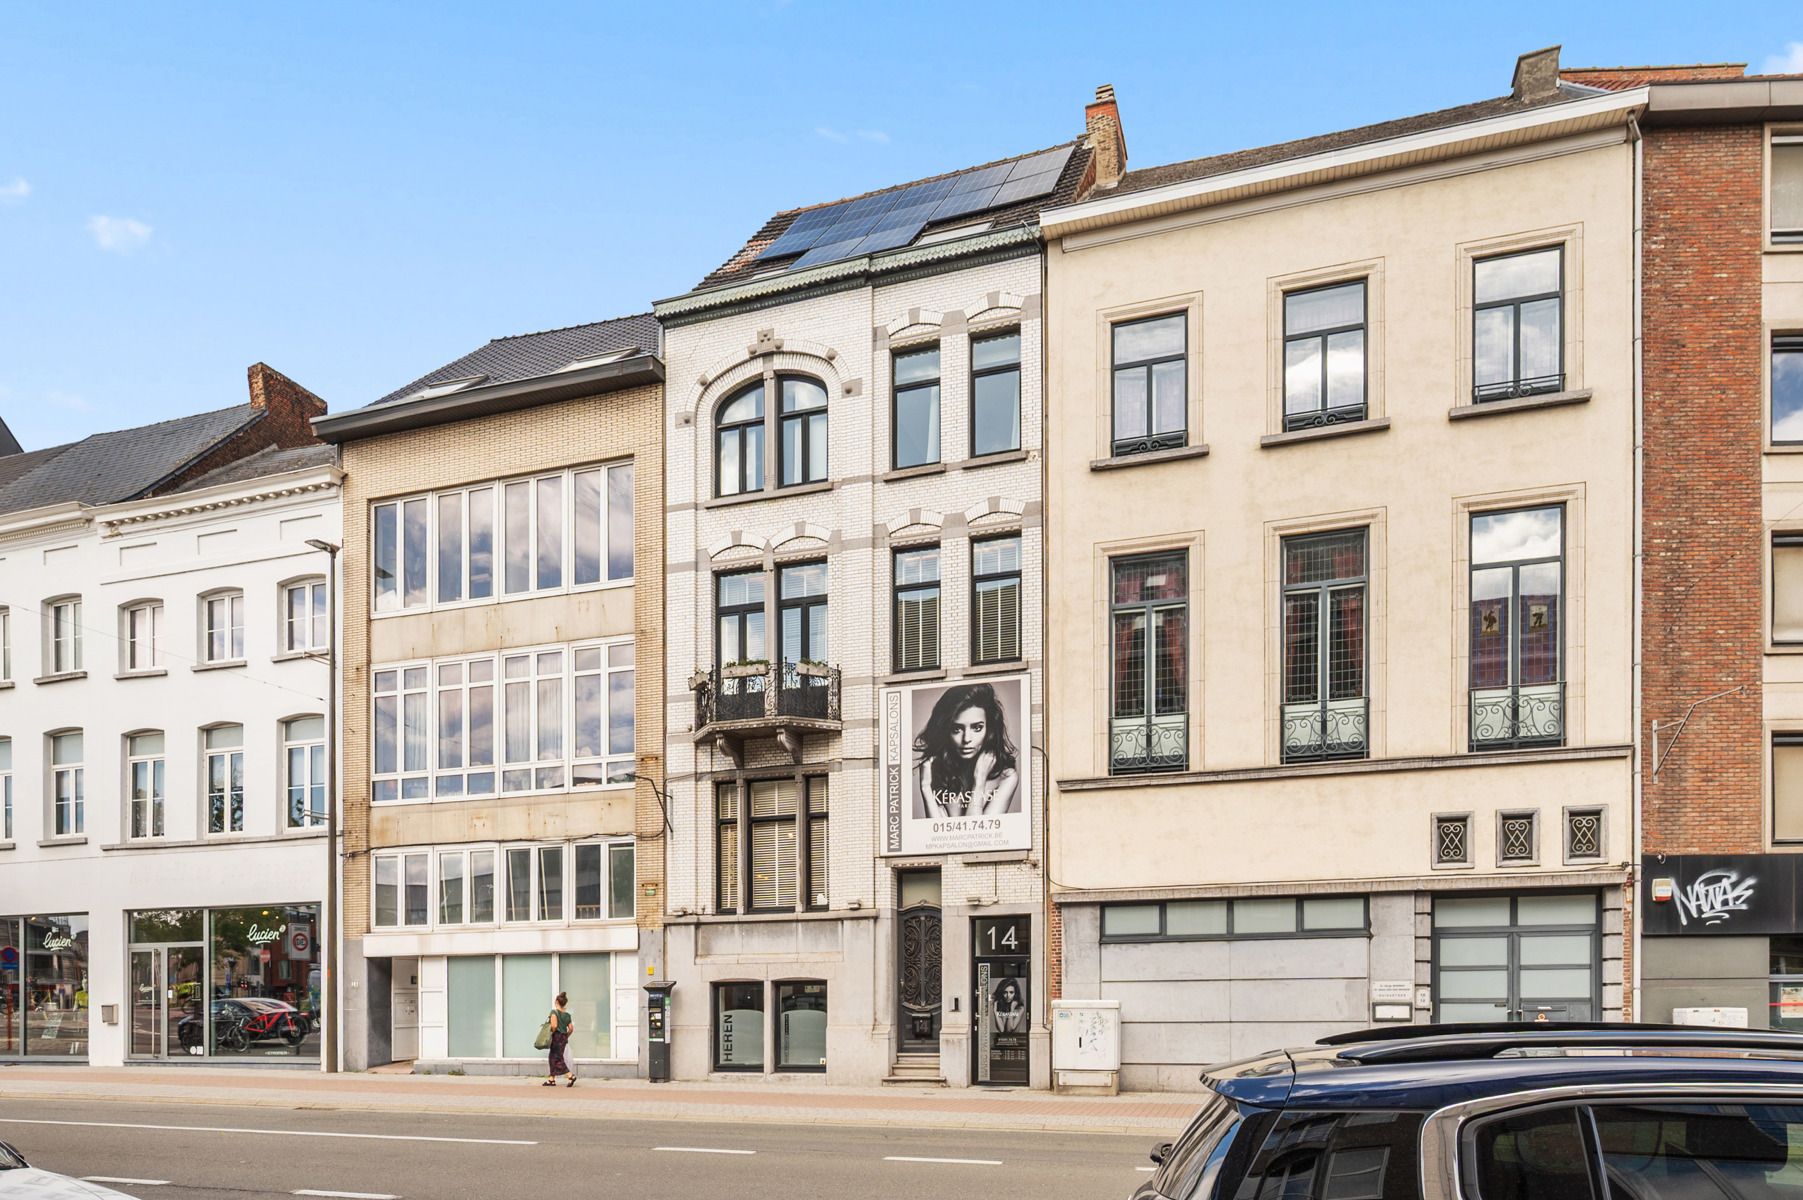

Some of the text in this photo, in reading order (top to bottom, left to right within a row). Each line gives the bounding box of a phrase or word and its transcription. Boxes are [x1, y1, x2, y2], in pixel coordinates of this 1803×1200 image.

[890, 695, 901, 849] MARC PATRICK KAPSALONS
[933, 819, 1001, 833] 015/41.74.79
[931, 832, 1003, 842] WWW.MARCPATRICK.BE
[43, 932, 72, 951] lucien
[246, 923, 280, 944] lucien
[986, 926, 1018, 951] 14
[914, 1020, 929, 1033] 14
[723, 1014, 733, 1062] HEREN
